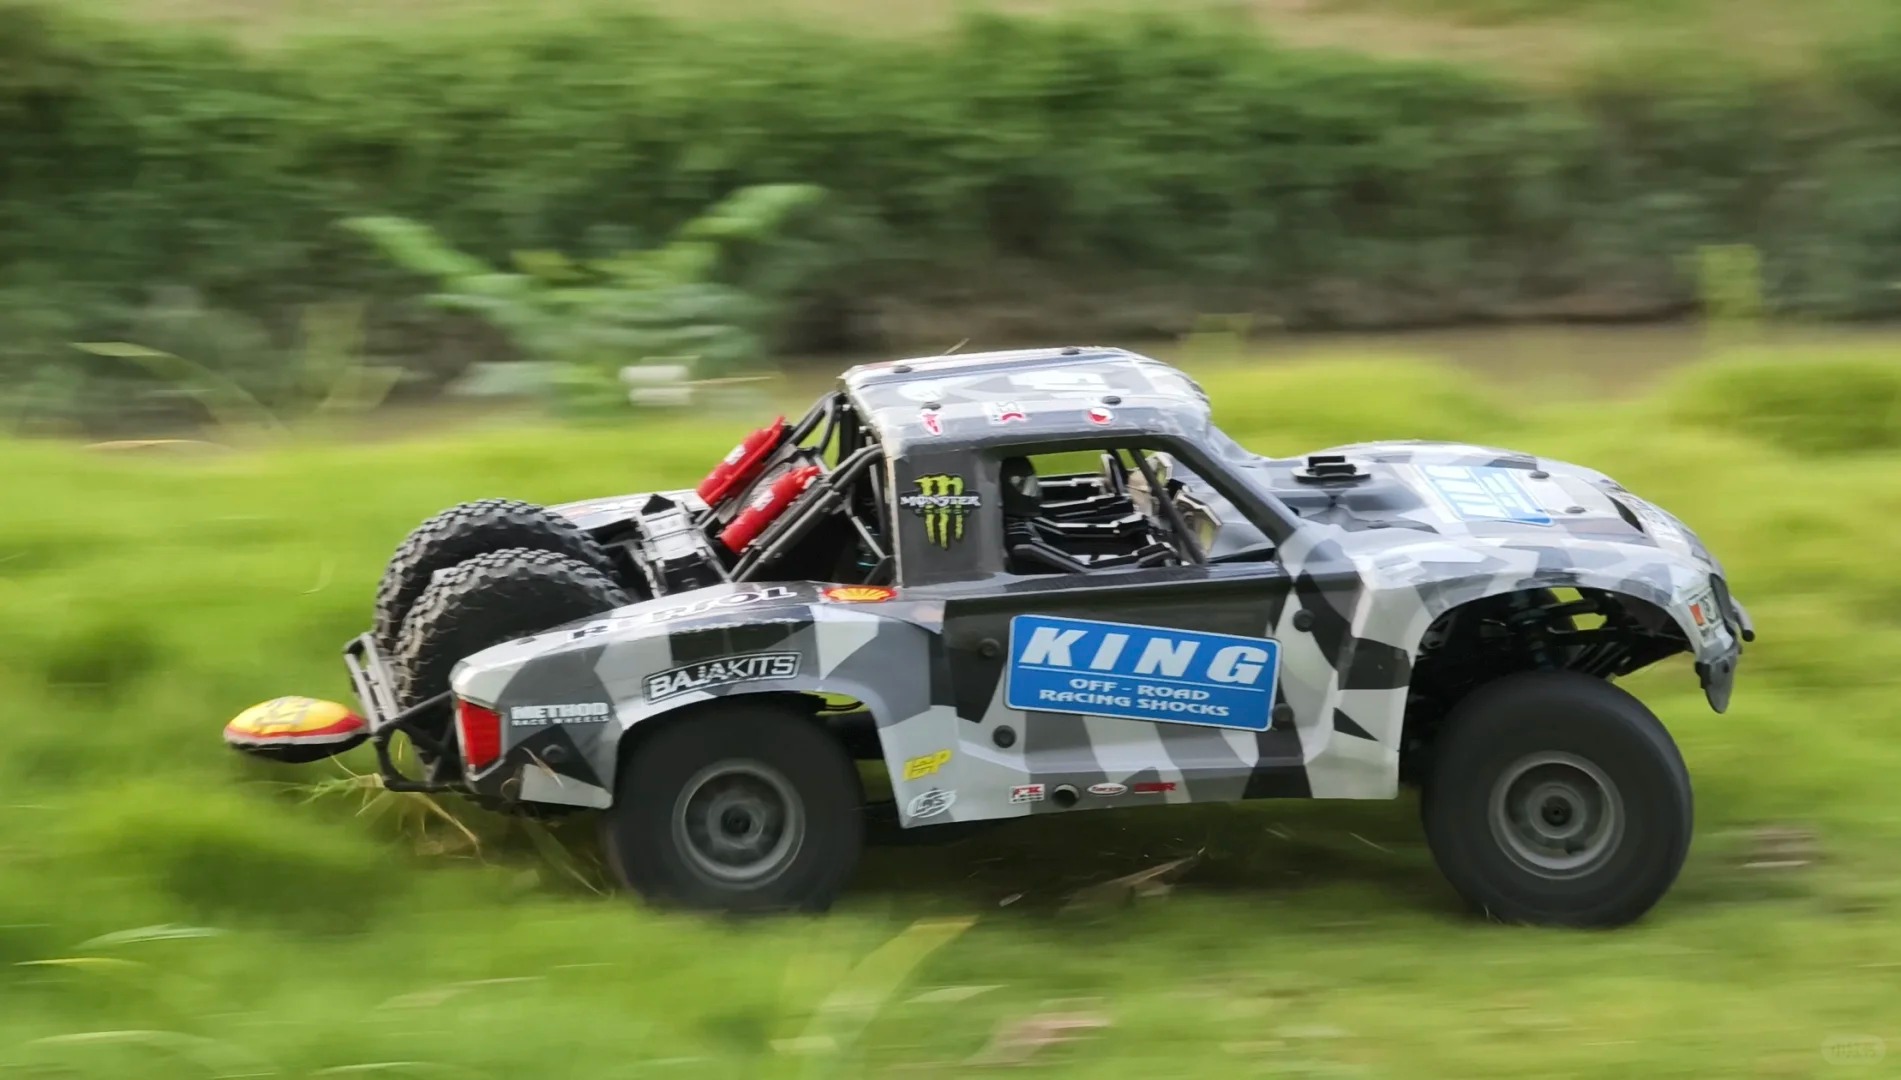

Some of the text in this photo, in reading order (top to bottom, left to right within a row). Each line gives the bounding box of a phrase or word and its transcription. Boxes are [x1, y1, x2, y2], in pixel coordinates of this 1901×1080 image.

[900, 494, 981, 508] MONSTER
[1018, 626, 1269, 685] KING
[1069, 678, 1118, 693] OFF
[1137, 684, 1210, 701] ROAD
[511, 703, 609, 719] METHOD
[1039, 689, 1231, 717] RACING SHOCKS
